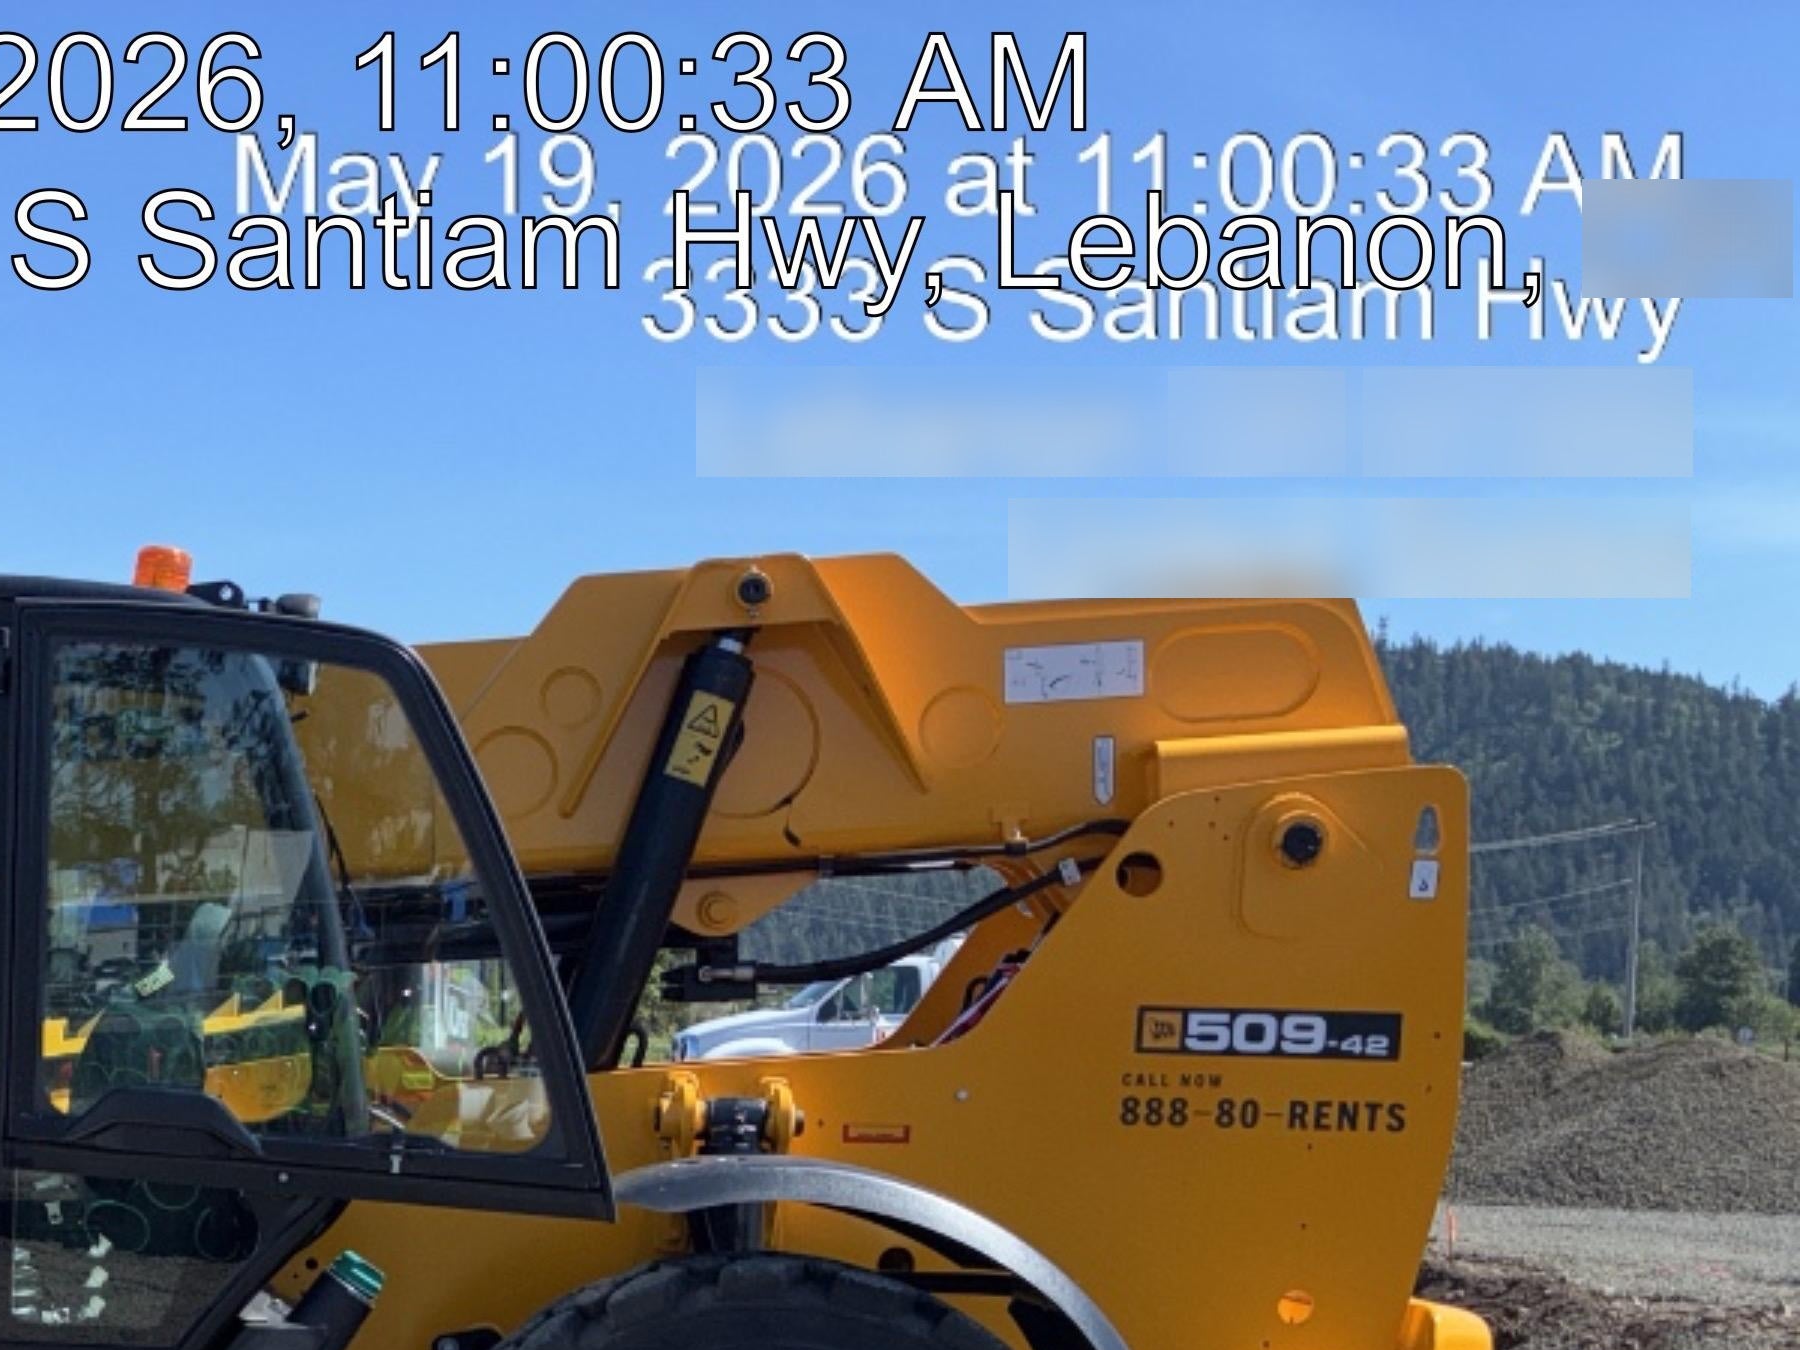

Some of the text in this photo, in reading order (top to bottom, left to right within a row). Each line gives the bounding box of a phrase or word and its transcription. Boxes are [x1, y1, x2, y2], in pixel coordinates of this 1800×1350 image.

[1184, 1012, 1389, 1057] 509-42
[1121, 1074, 1222, 1088] CALL NOW
[1120, 1096, 1406, 1132] 888-80-RENTS
